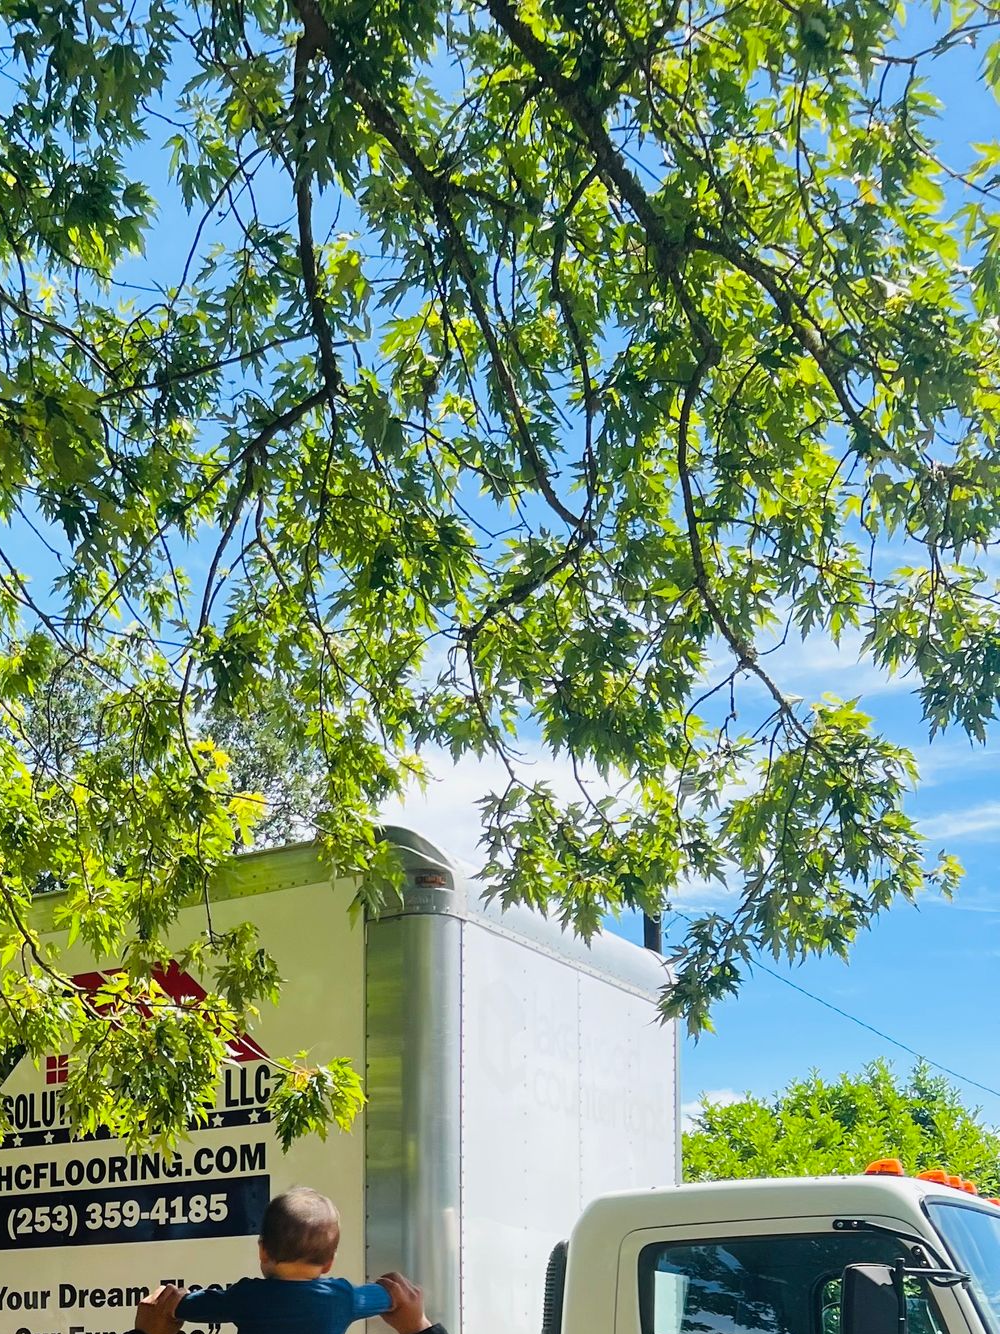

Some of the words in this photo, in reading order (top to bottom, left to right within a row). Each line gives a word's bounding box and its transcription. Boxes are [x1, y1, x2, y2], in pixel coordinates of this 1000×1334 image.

[225, 1064, 271, 1108] LLC
[7, 1204, 78, 1240] (253)
[85, 1193, 228, 1230] 359-4185
[58, 1284, 150, 1309] Dream
